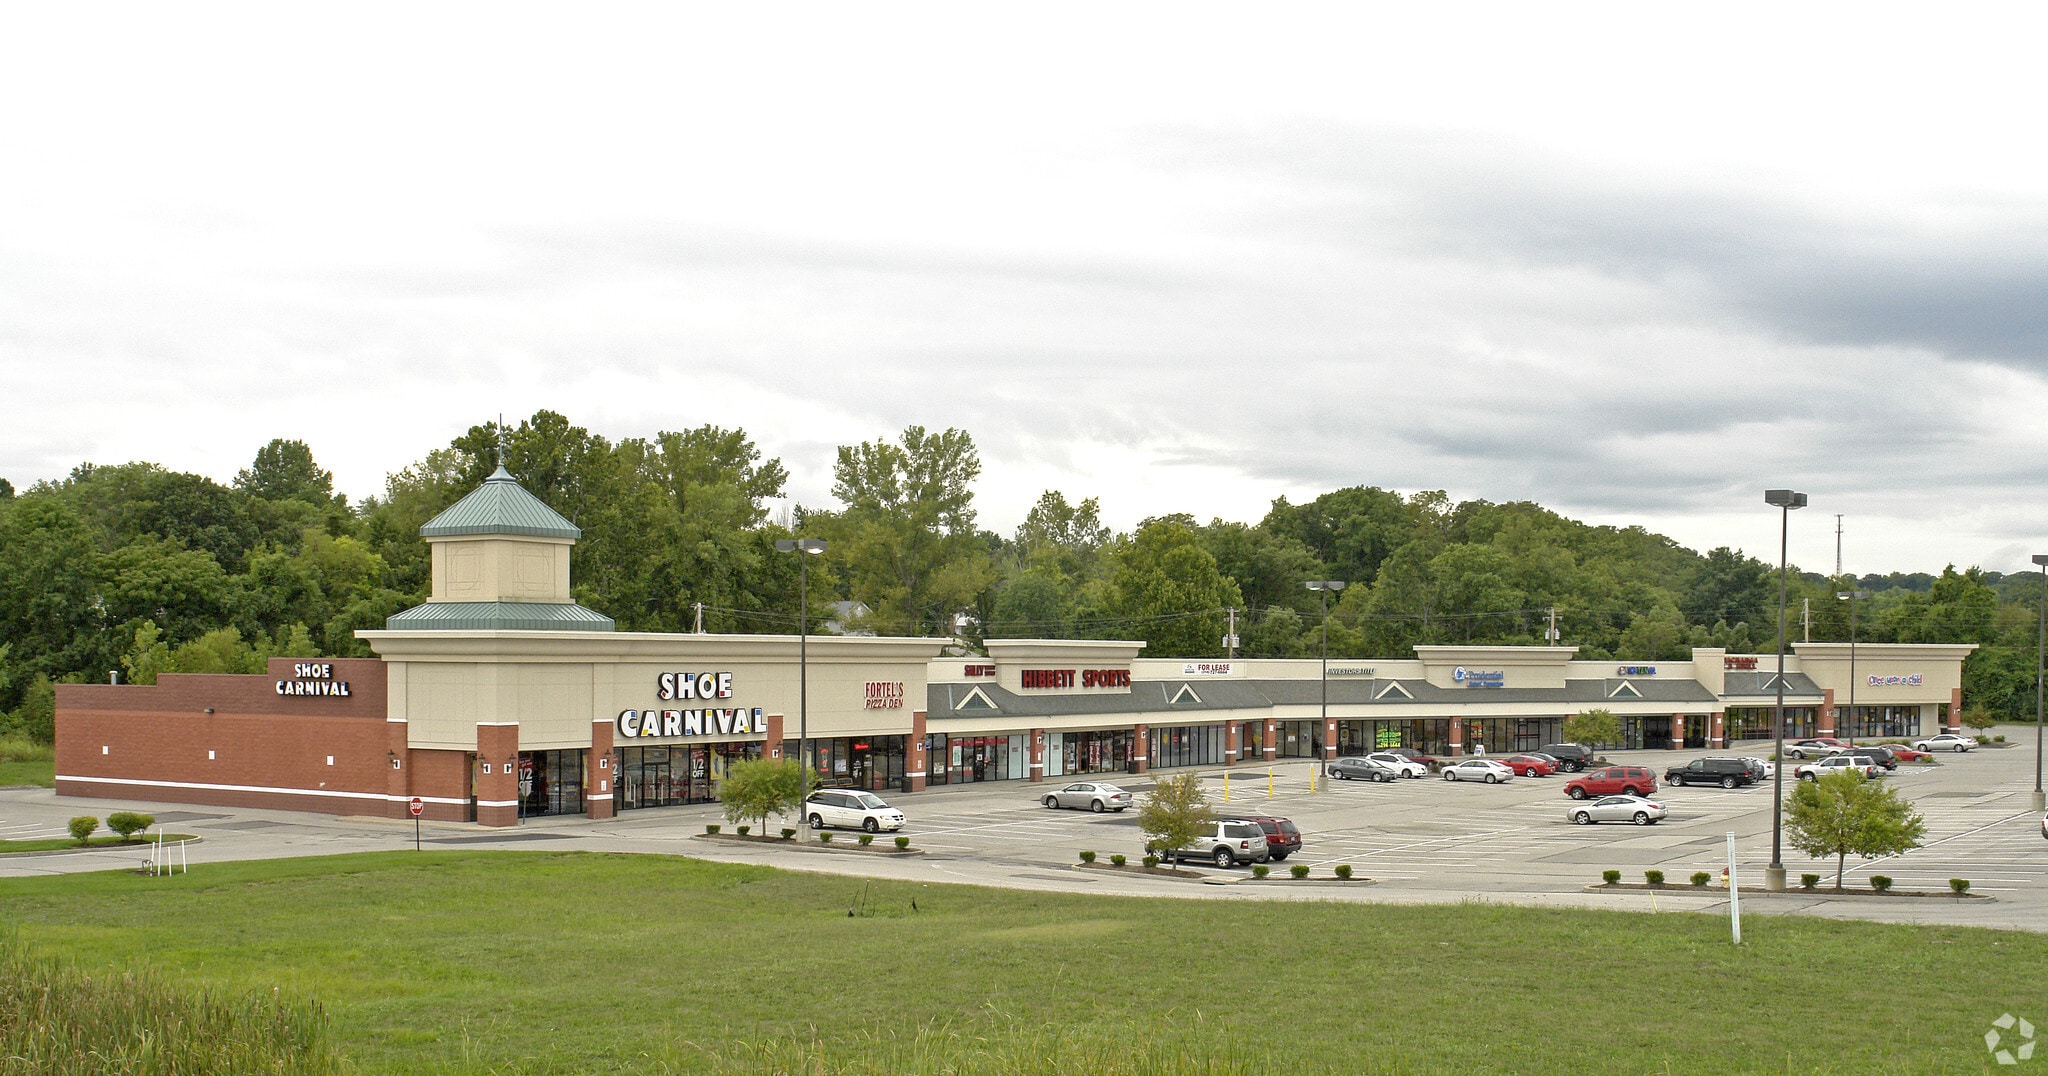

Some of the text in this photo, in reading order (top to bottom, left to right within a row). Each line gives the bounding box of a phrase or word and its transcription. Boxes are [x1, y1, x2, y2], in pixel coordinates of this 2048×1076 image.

[294, 663, 332, 679] SHOE
[1021, 669, 1131, 688] HIBBETT SPORTS
[275, 680, 350, 697] CARNIVAL
[658, 672, 732, 700] SHOE
[864, 681, 904, 698] FORTEL'S
[864, 699, 904, 709] PIZZA DEN
[618, 708, 767, 738] CARNIVAL
[692, 758, 704, 770] 1/2
[519, 768, 533, 781] 1/2
[692, 770, 705, 778] OFF
